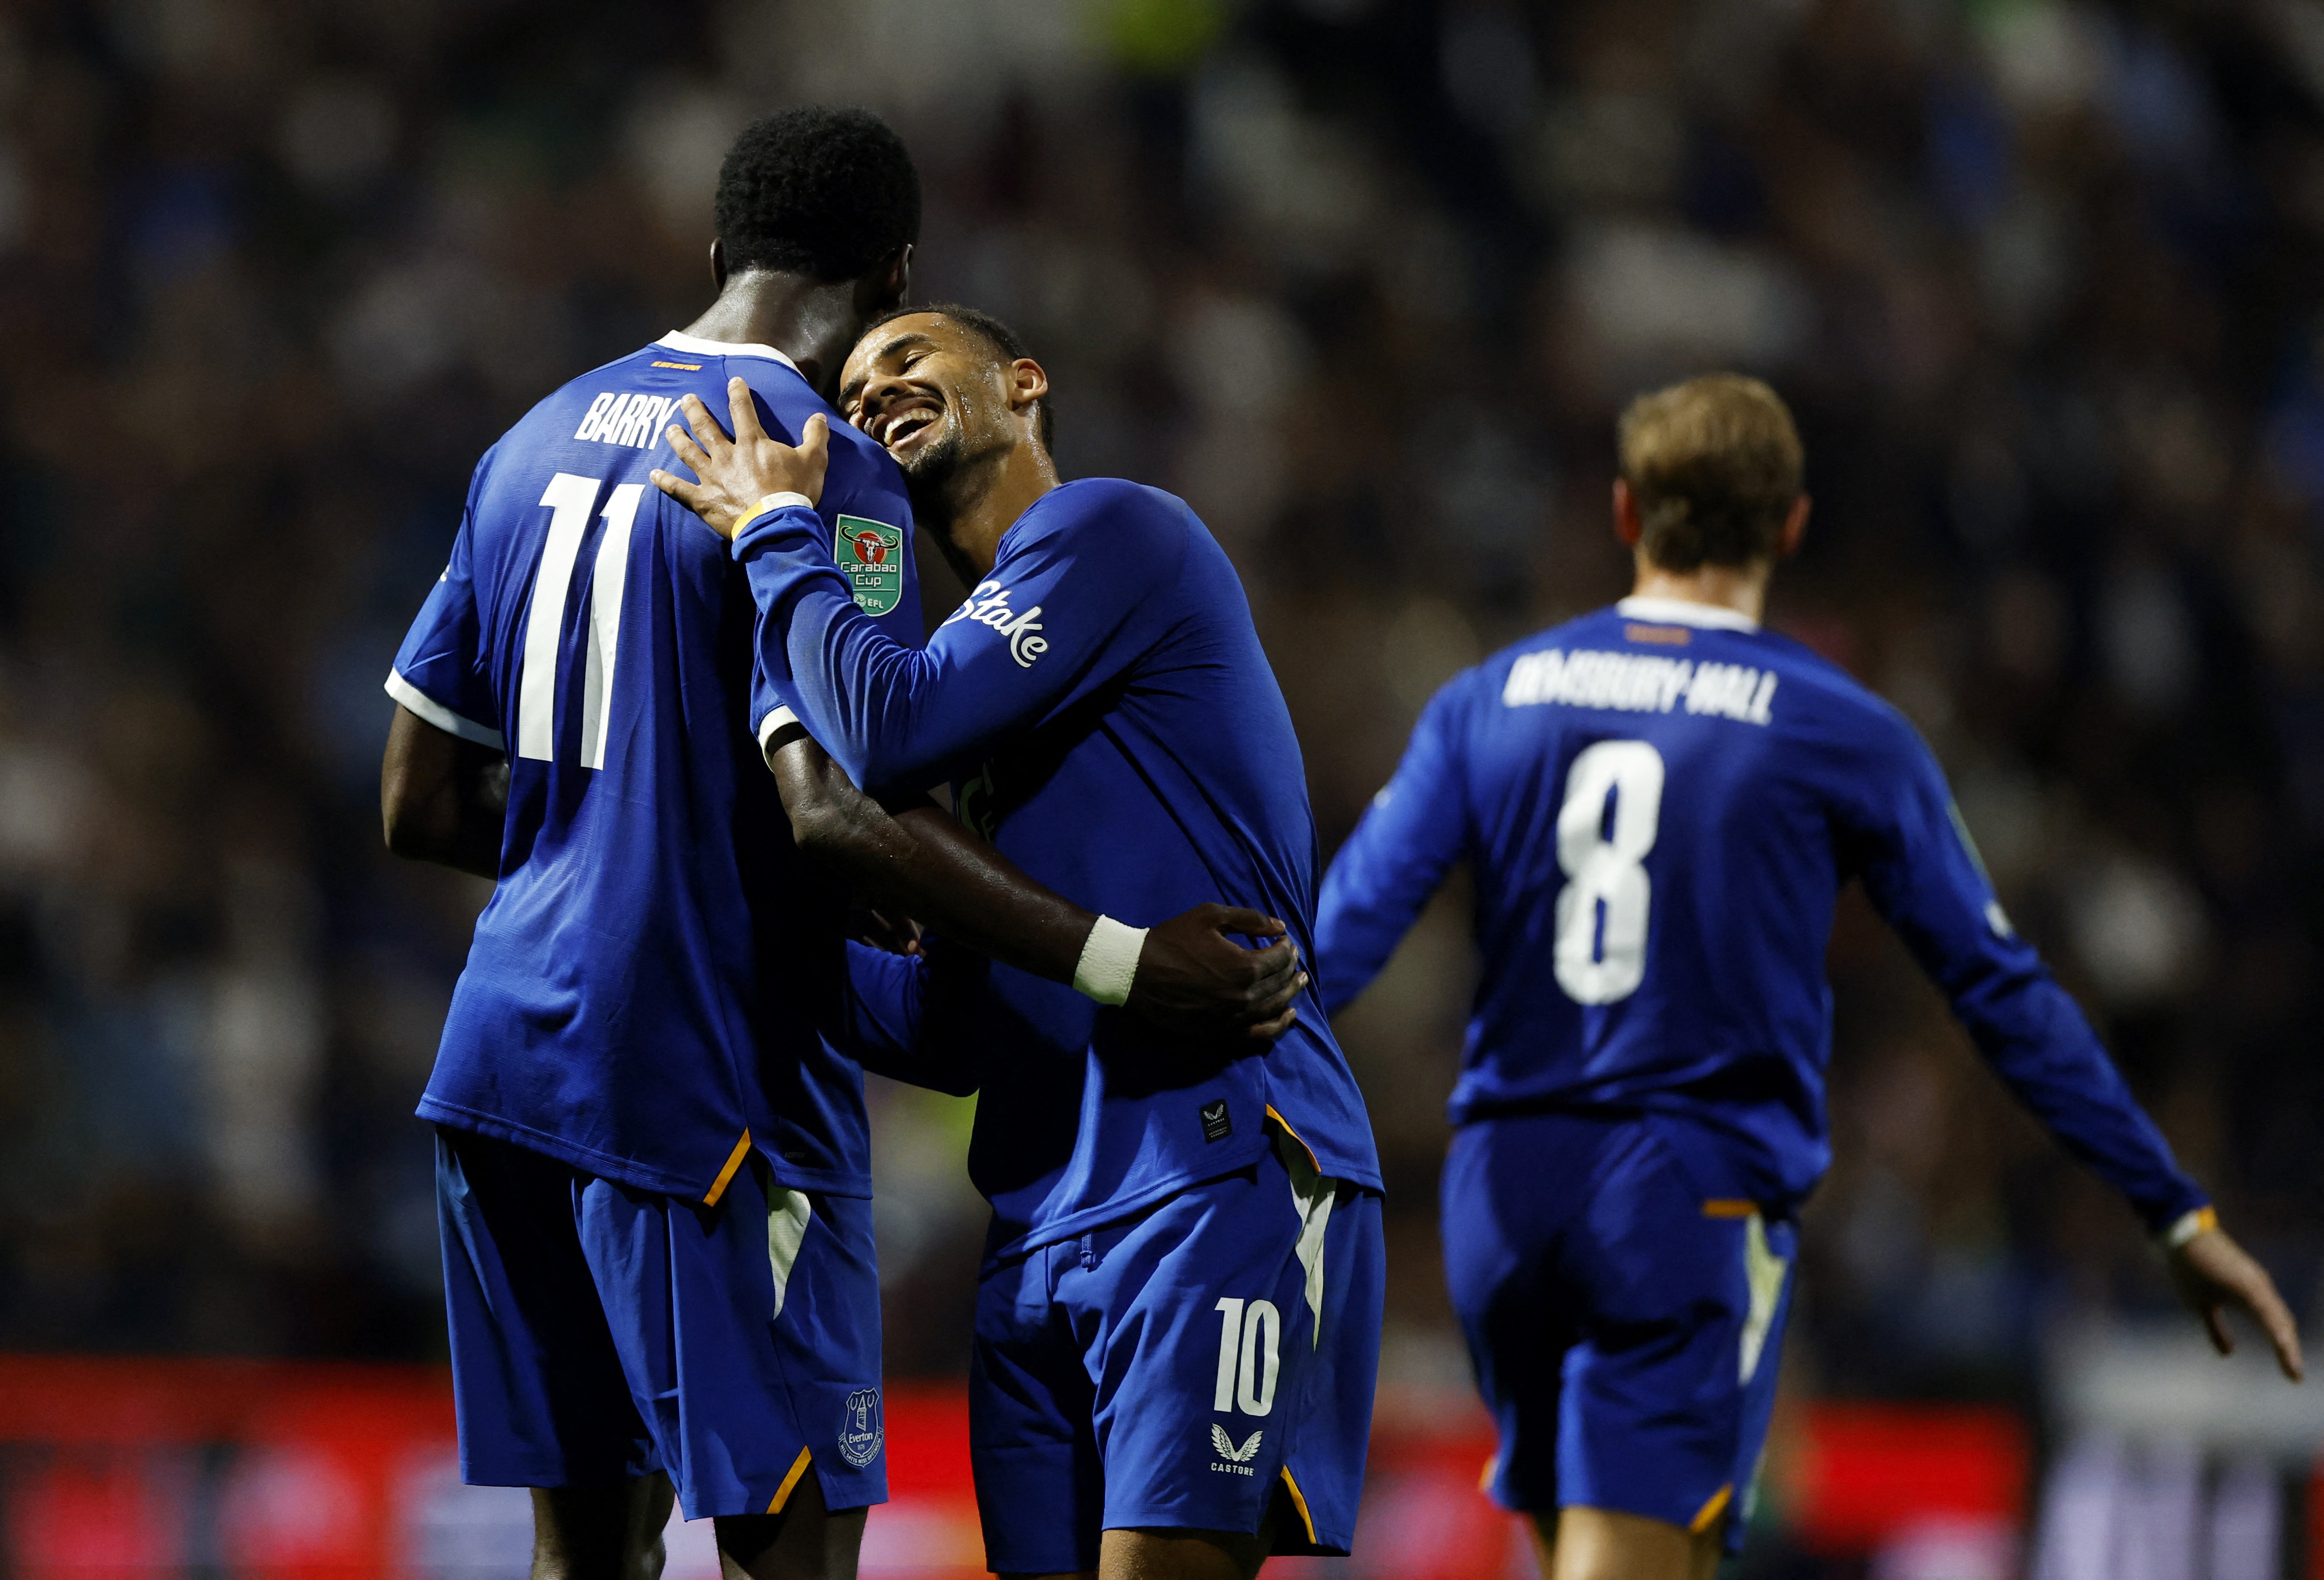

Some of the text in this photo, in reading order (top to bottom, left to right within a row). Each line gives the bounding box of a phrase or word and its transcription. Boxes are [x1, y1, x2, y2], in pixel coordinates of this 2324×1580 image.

[574, 392, 681, 450] BARRY
[840, 561, 897, 573] Carabao
[855, 574, 881, 587] Cup
[867, 598, 884, 609] EFL
[519, 473, 646, 771] 11
[940, 580, 1048, 668] Stake
[1553, 739, 1665, 1005] 8
[1214, 1297, 1280, 1417] 10
[849, 1432, 873, 1444] Everton
[1211, 1462, 1254, 1476] CASTORE
